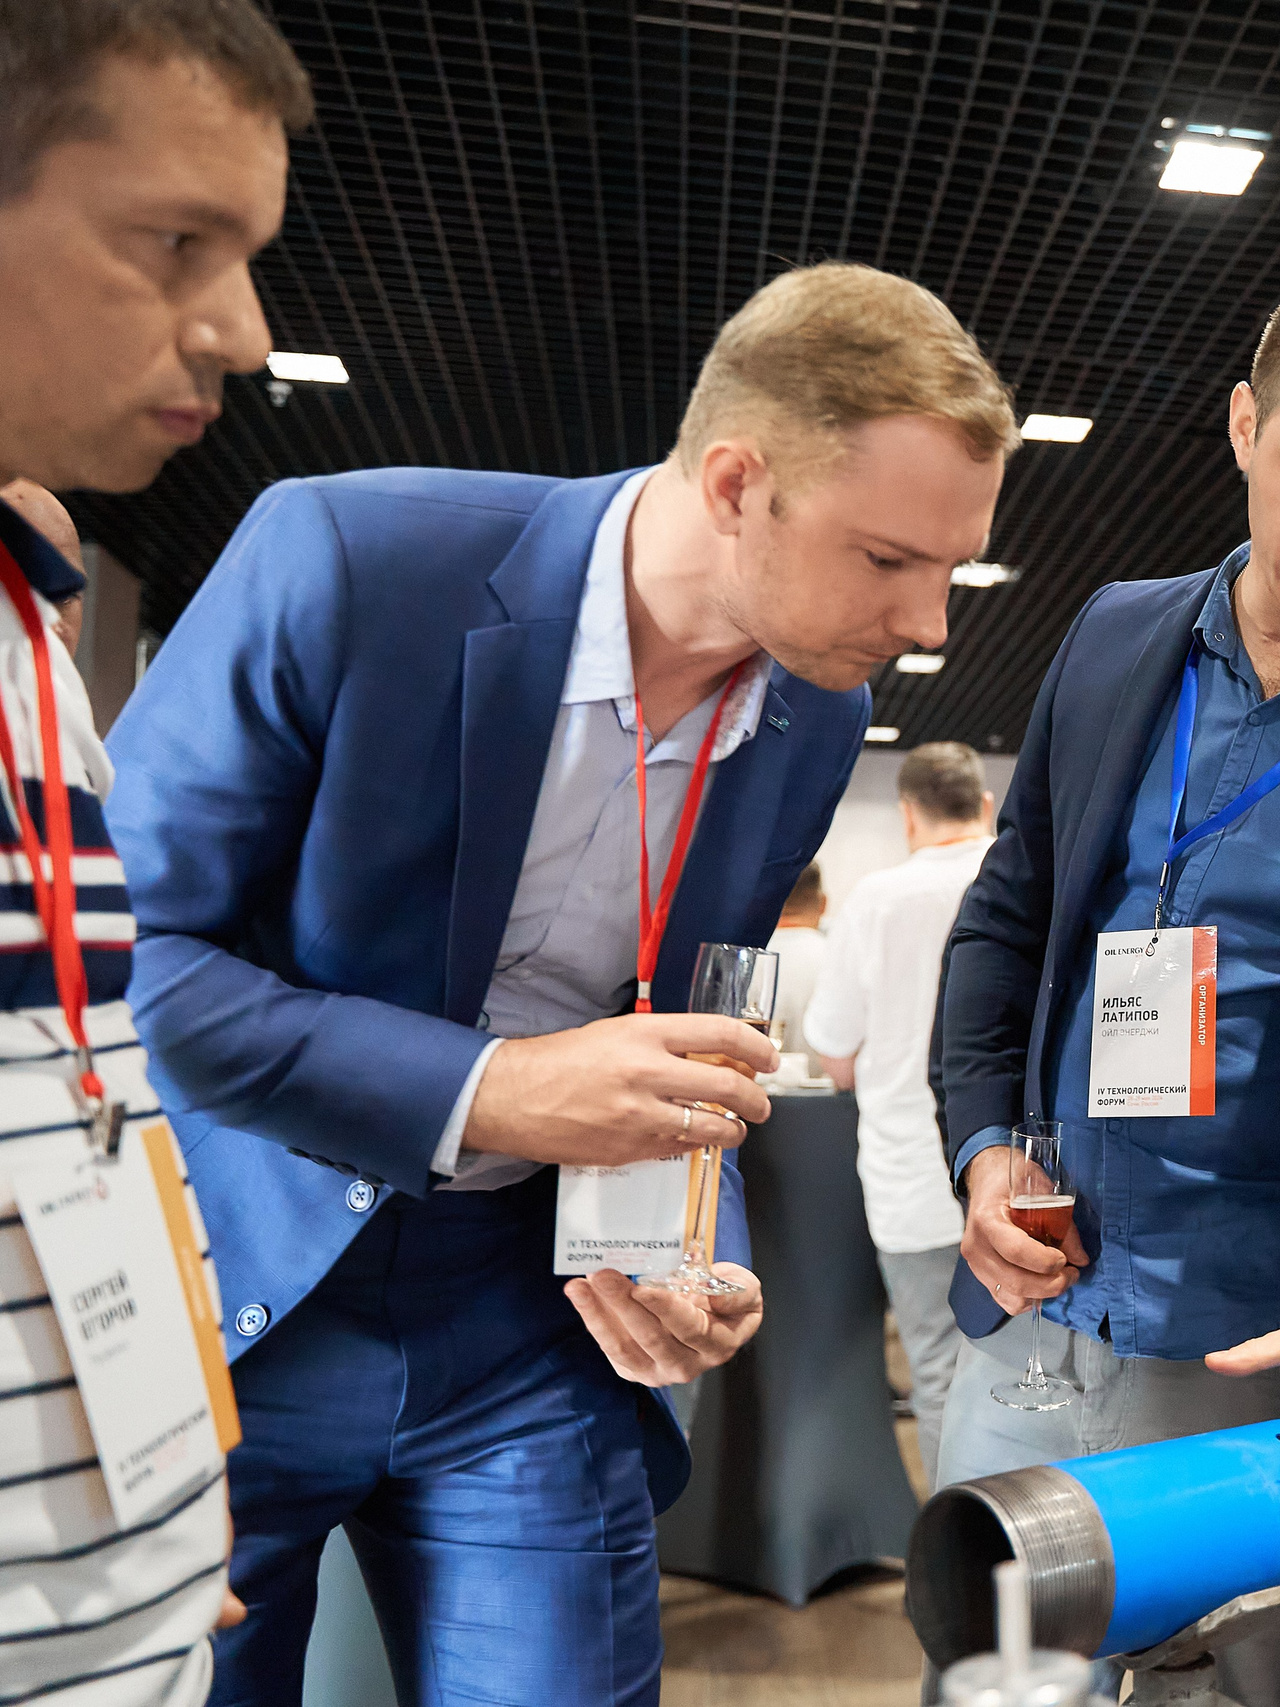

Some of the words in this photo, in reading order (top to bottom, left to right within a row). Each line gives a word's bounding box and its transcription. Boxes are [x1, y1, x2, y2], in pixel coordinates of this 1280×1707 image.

[1118, 947, 1145, 955] ENERGY
[1102, 996, 1142, 1009] ИЛЬЯС
[1101, 1010, 1159, 1023] ЛАТИПОВ
[1198, 985, 1207, 1046] ОРГАНИЗАТОР
[1101, 1028, 1118, 1037] ОЙЛ
[1107, 1085, 1187, 1095] ТЕХНОЛОГИЧЕСКИЙ
[1097, 1098, 1125, 1106] ФОРУМ
